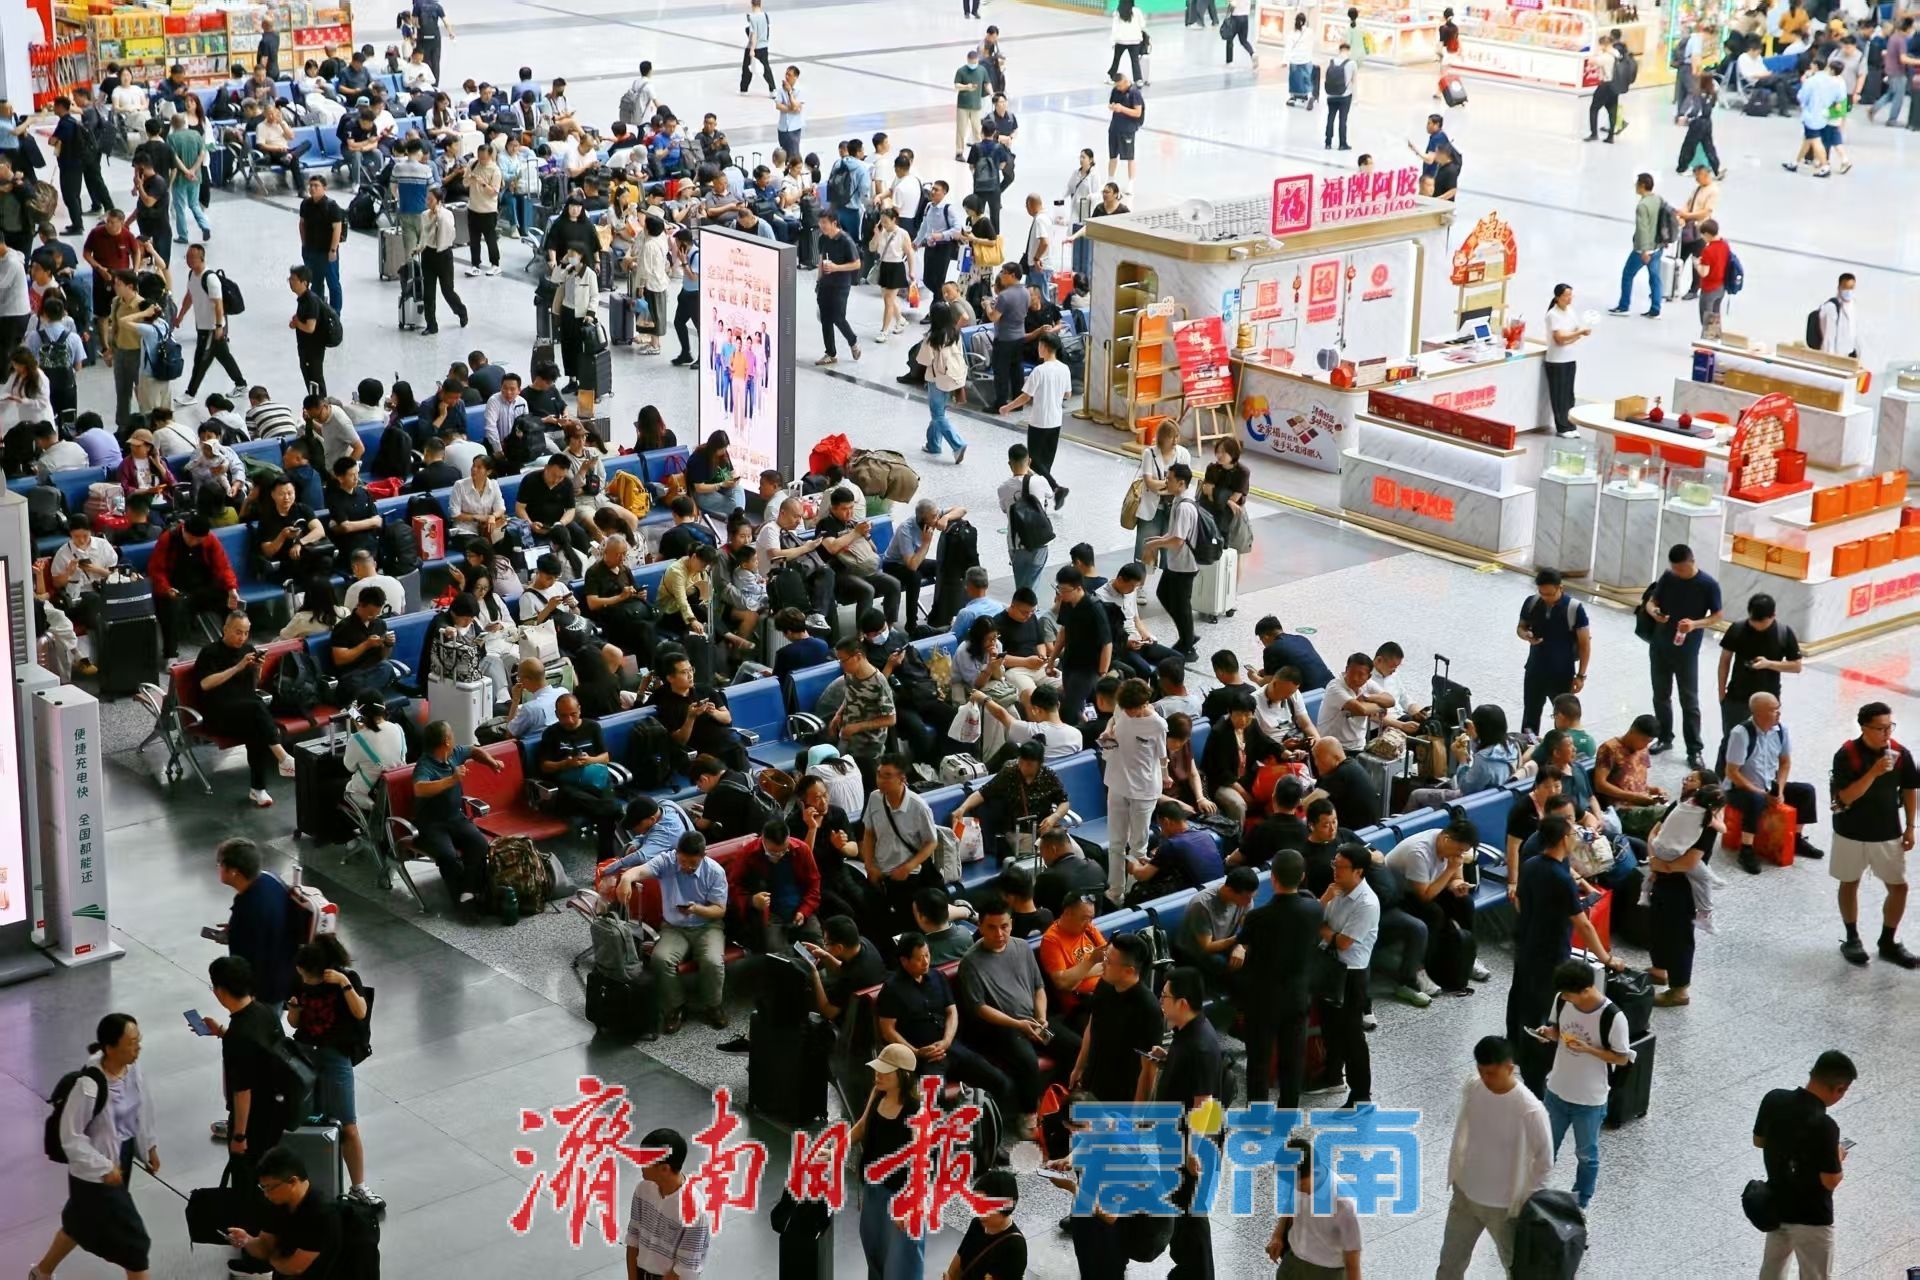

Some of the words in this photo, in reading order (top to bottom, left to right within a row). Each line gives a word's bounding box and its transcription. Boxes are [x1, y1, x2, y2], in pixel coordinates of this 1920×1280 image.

[1320, 166, 1419, 209] 福牌阿胶
[1383, 199, 1415, 216] JIAO
[74, 727, 89, 799] 便捷充电快
[78, 813, 94, 884] 全国都能还
